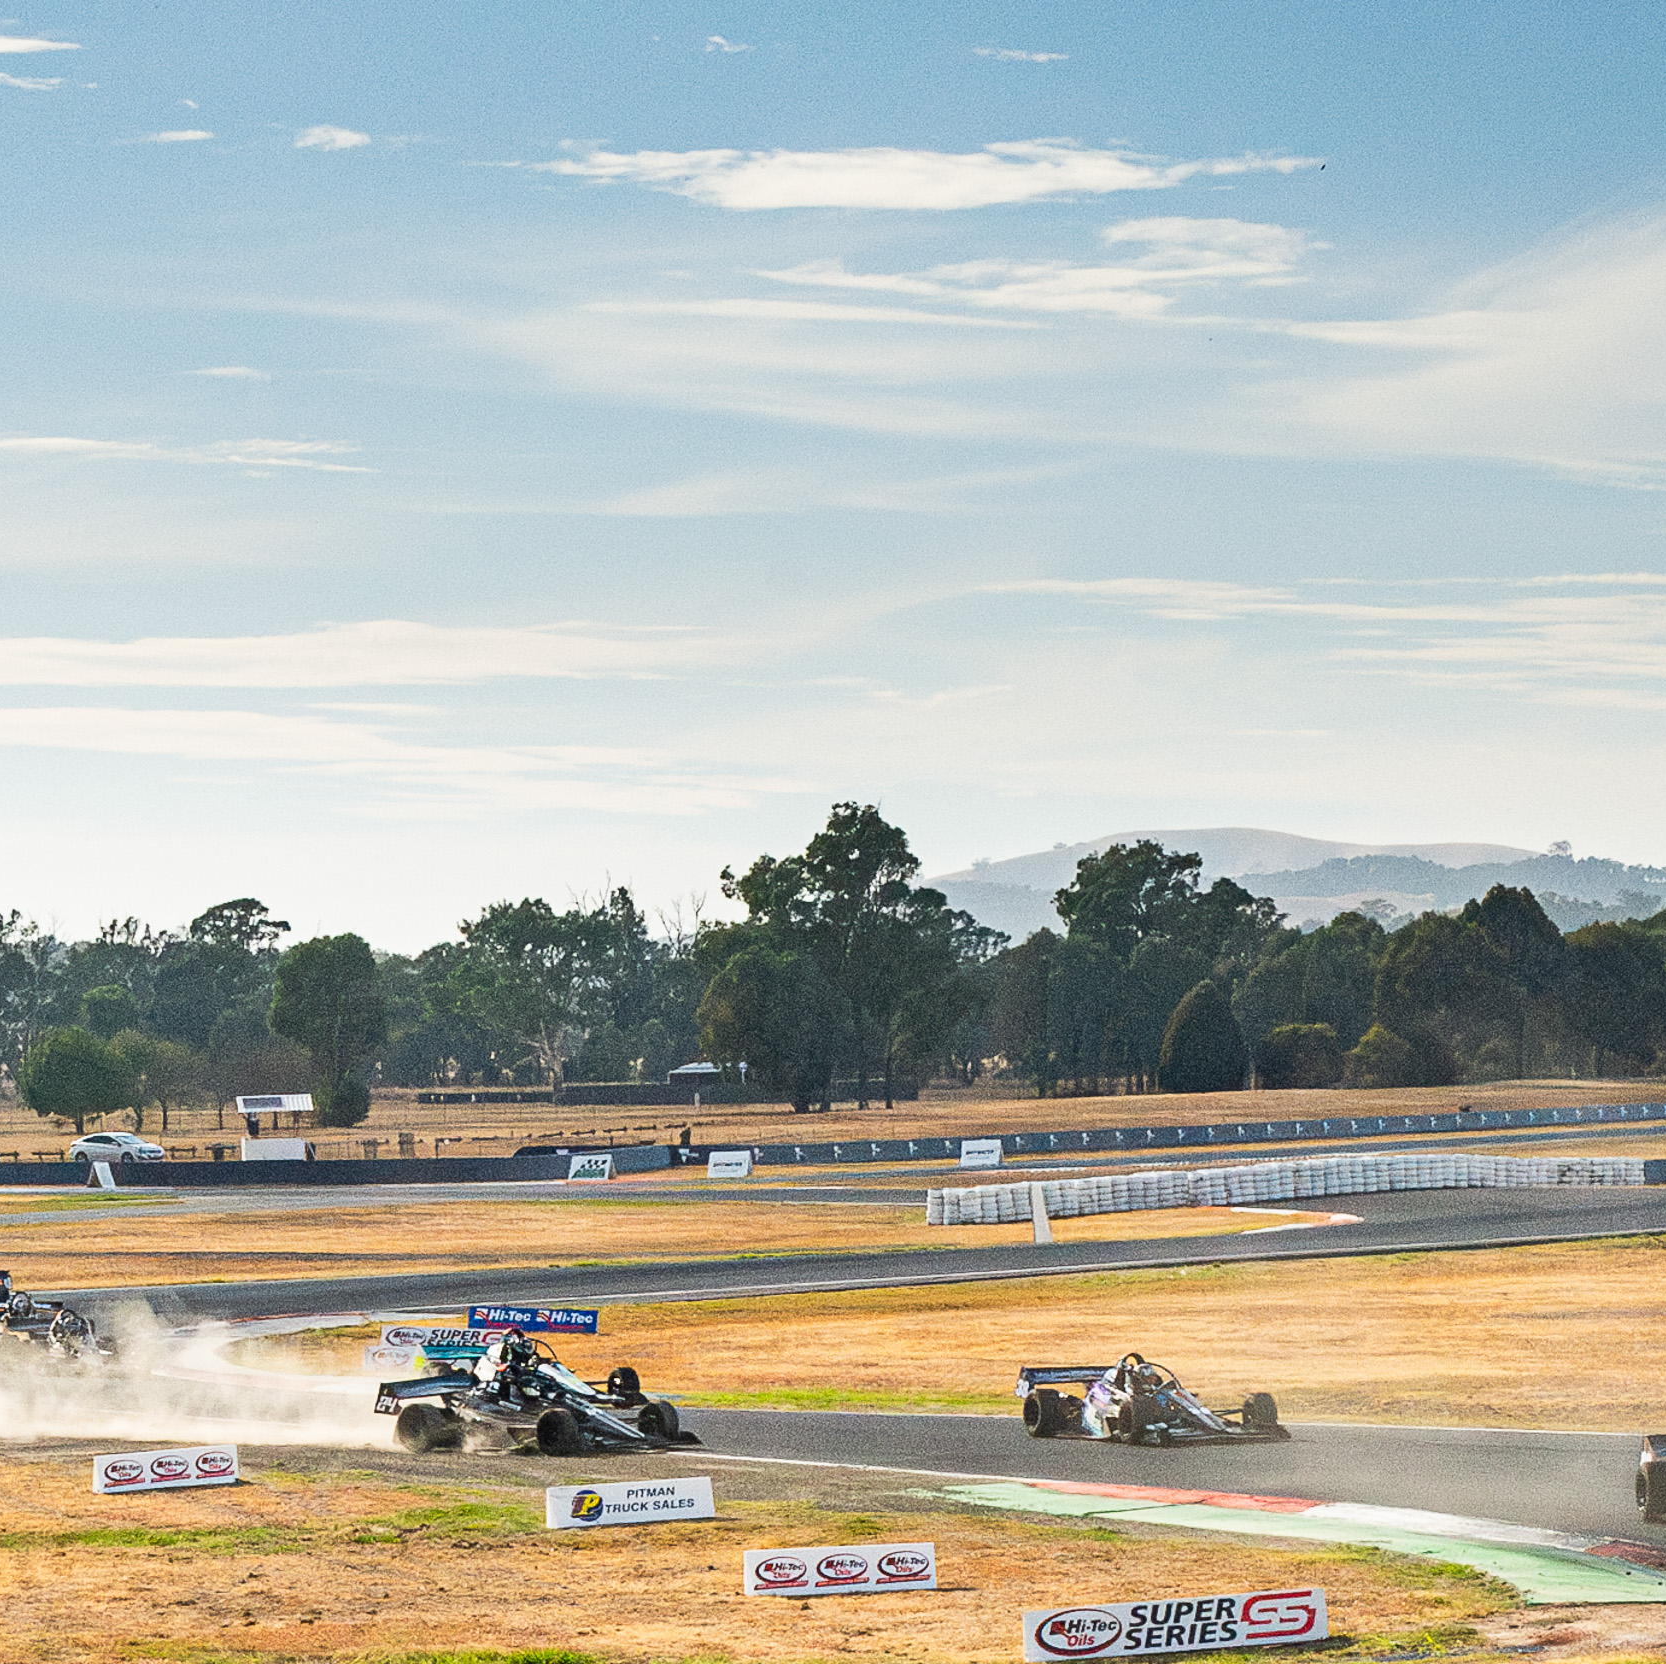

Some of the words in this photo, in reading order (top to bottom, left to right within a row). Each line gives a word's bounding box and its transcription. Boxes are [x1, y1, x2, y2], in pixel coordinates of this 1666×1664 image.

[430, 1329, 481, 1341] SUPER
[626, 1486, 676, 1499] PITMAN
[605, 1502, 649, 1514] TRUCK
[652, 1498, 695, 1509] SALES
[1129, 1598, 1236, 1628] SUPER
[1066, 1618, 1117, 1634] Hi-Tec
[1067, 1634, 1095, 1648] Oils
[1124, 1620, 1238, 1650] SERIES
